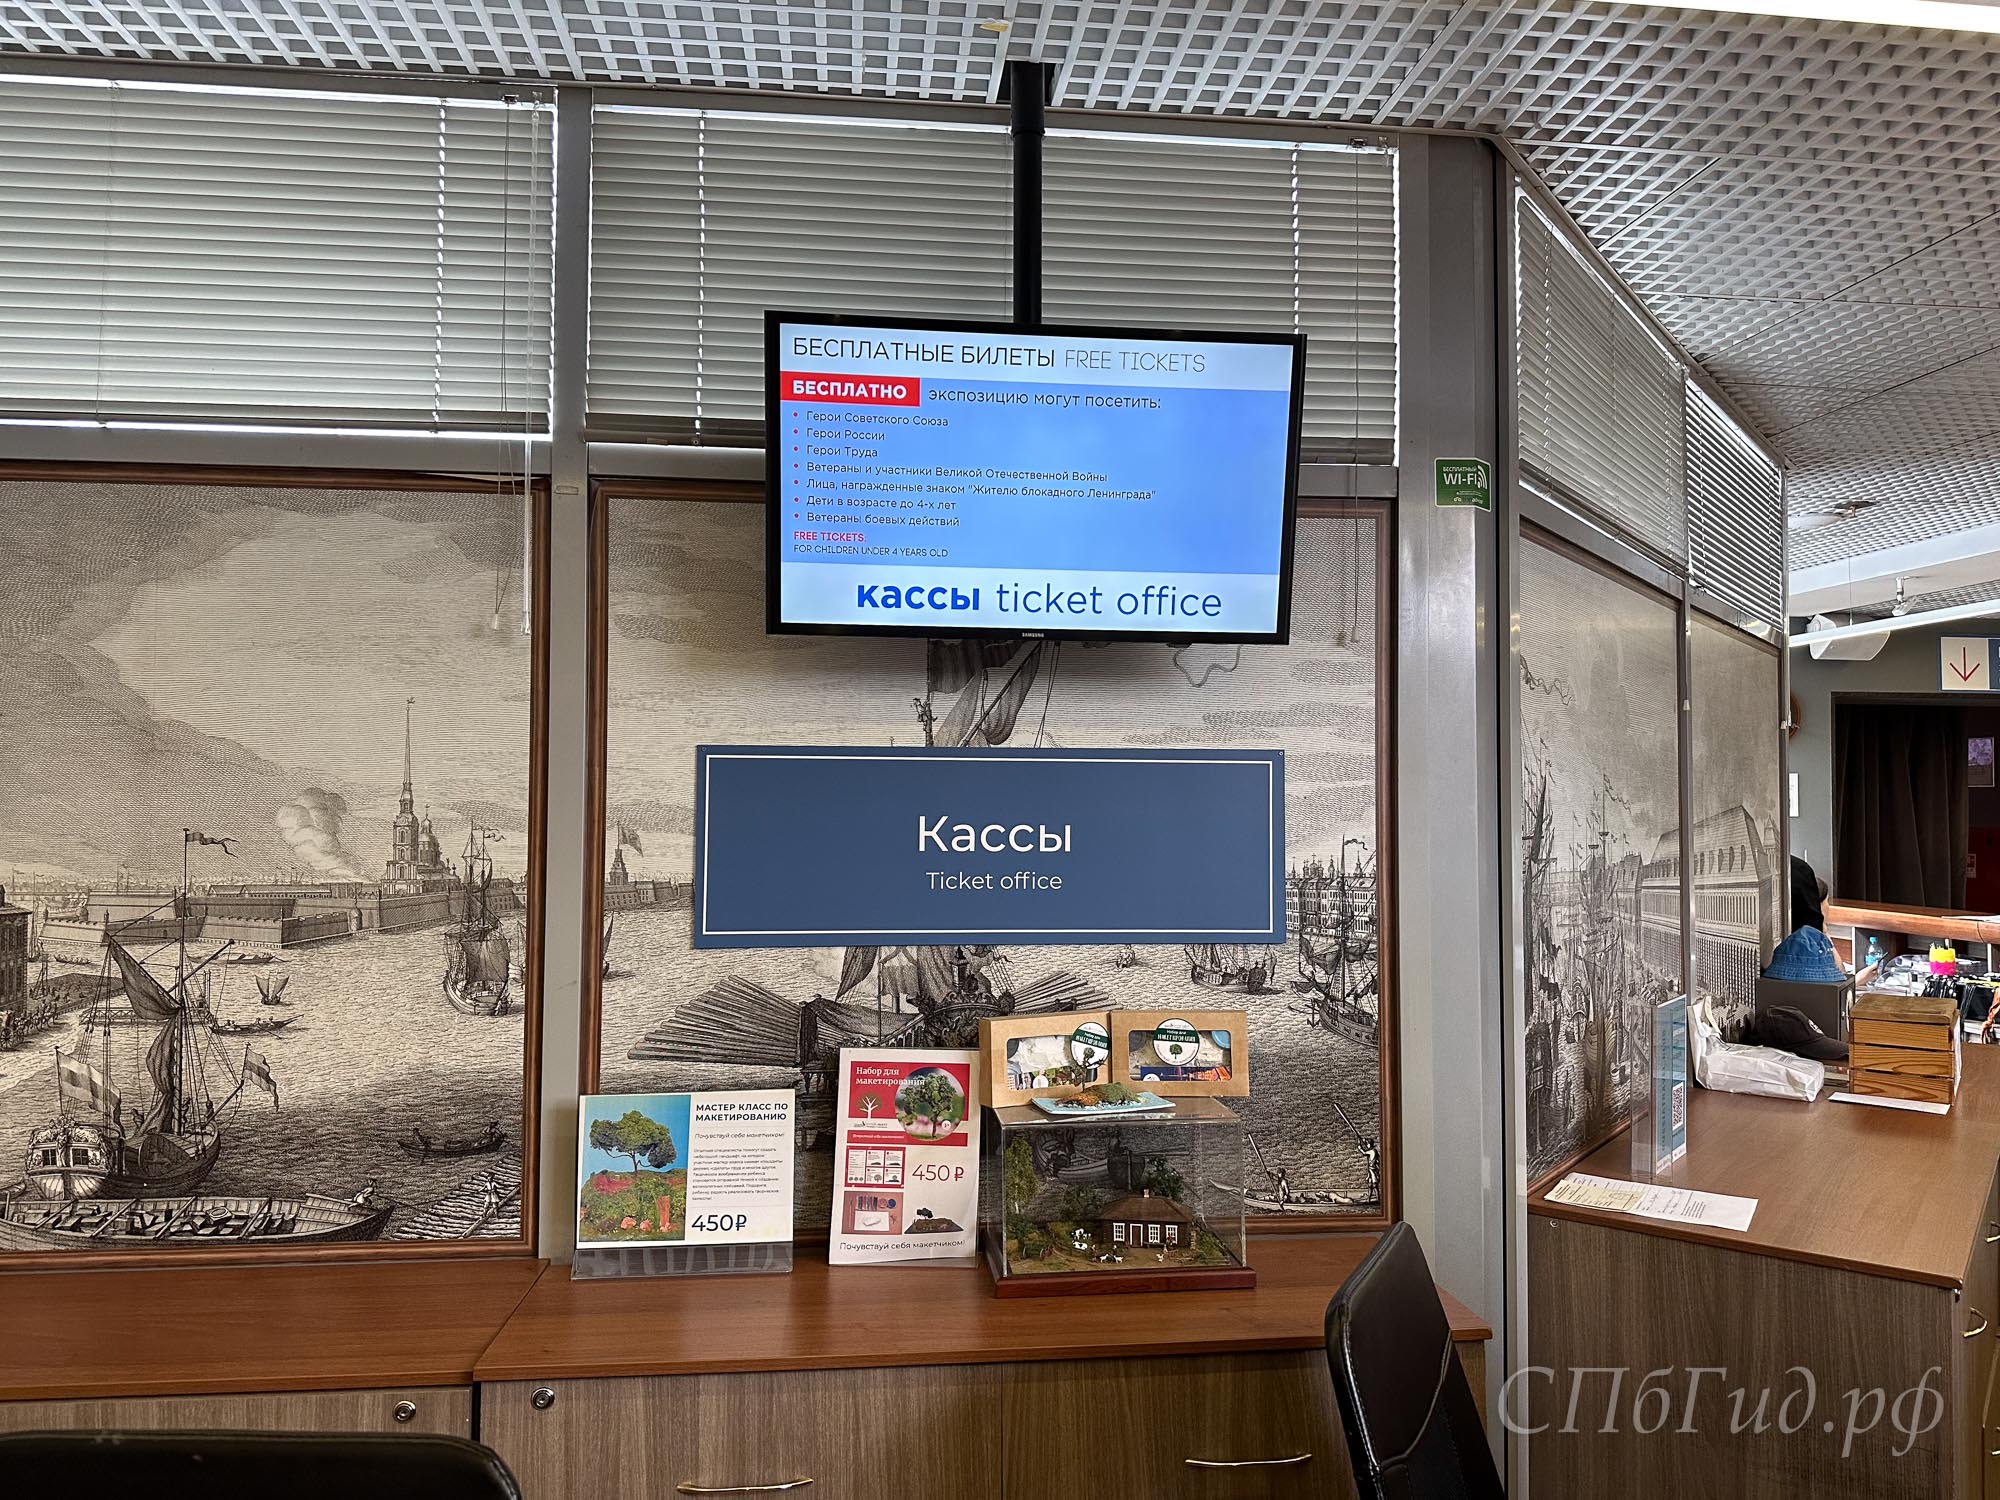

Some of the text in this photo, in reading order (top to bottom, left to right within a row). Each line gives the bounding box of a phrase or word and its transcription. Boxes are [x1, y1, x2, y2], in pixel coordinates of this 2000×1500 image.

[793, 337, 1055, 367] БЕСПЛАТНЫЕ БИЛЕТЫ
[1065, 349, 1206, 373] FREE TICKETS
[792, 379, 907, 399] БЕСПЛАТНО
[928, 389, 1161, 409] экспозицию могут посетить:
[806, 411, 949, 427] Герои Советского Союза
[806, 428, 885, 441] Герои России
[806, 445, 878, 459] Герои Труда
[807, 462, 1108, 482] Ветераны и участники Великой Отечественной Войны
[1443, 472, 1477, 485] WI-FI
[806, 479, 1156, 500] Лица, награжденные знаком "Жителю блокадного Ленинграда"
[806, 496, 957, 510] Дети в возрасте до 4-х лет
[807, 512, 961, 527] Ветераны боевых действий
[793, 531, 818, 541] FREE
[793, 545, 949, 557] FOR CHILDREN UNDER 4 YEARS OLD
[857, 584, 980, 611] кассы
[996, 582, 1223, 618] ticket office
[917, 815, 1072, 854] Кассы
[926, 871, 1063, 890] Ticket office
[856, 1066, 899, 1076] Набор для
[855, 1078, 925, 1087] макетирования
[696, 1103, 736, 1112] МАСТЕР
[738, 1103, 771, 1111] КЛАСС
[695, 1113, 787, 1122] МАКЕТИРОВАНИЮ
[912, 1164, 950, 1181] 450
[839, 1242, 889, 1251] Почувствуй
[891, 1241, 911, 1249] себя
